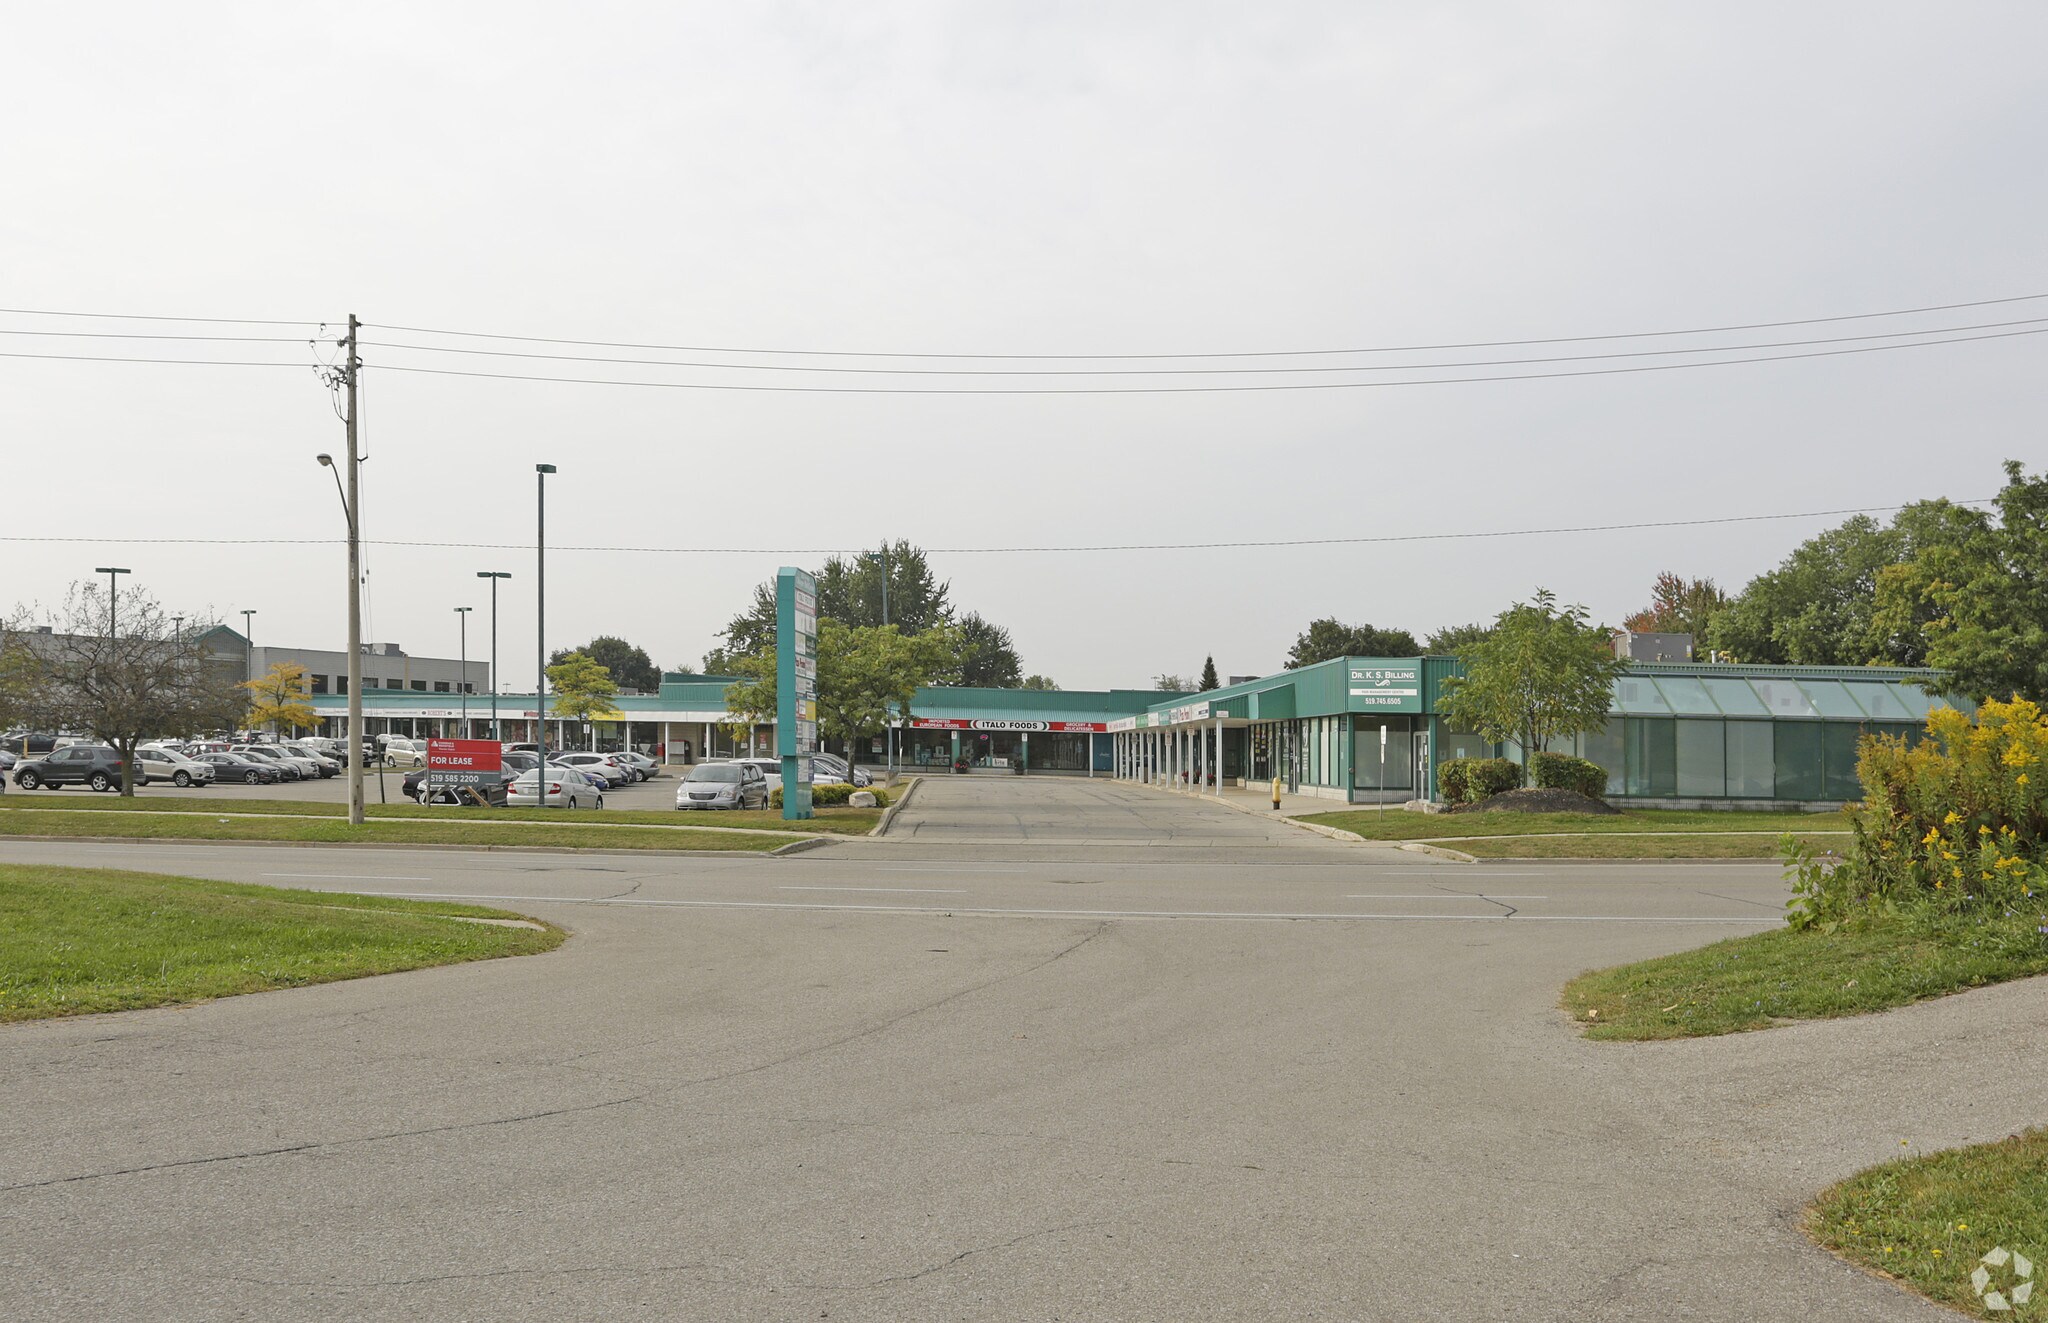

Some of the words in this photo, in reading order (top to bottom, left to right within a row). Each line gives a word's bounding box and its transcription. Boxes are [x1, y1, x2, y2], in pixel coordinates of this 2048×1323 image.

[1366, 671, 1374, 679] K.
[1375, 671, 1383, 679] S.
[982, 721, 1006, 729] ITALO
[431, 756, 447, 764] FOR
[449, 757, 473, 765] LEASE
[431, 774, 443, 782] 519
[445, 774, 458, 782] 585
[460, 775, 479, 783] 2200
